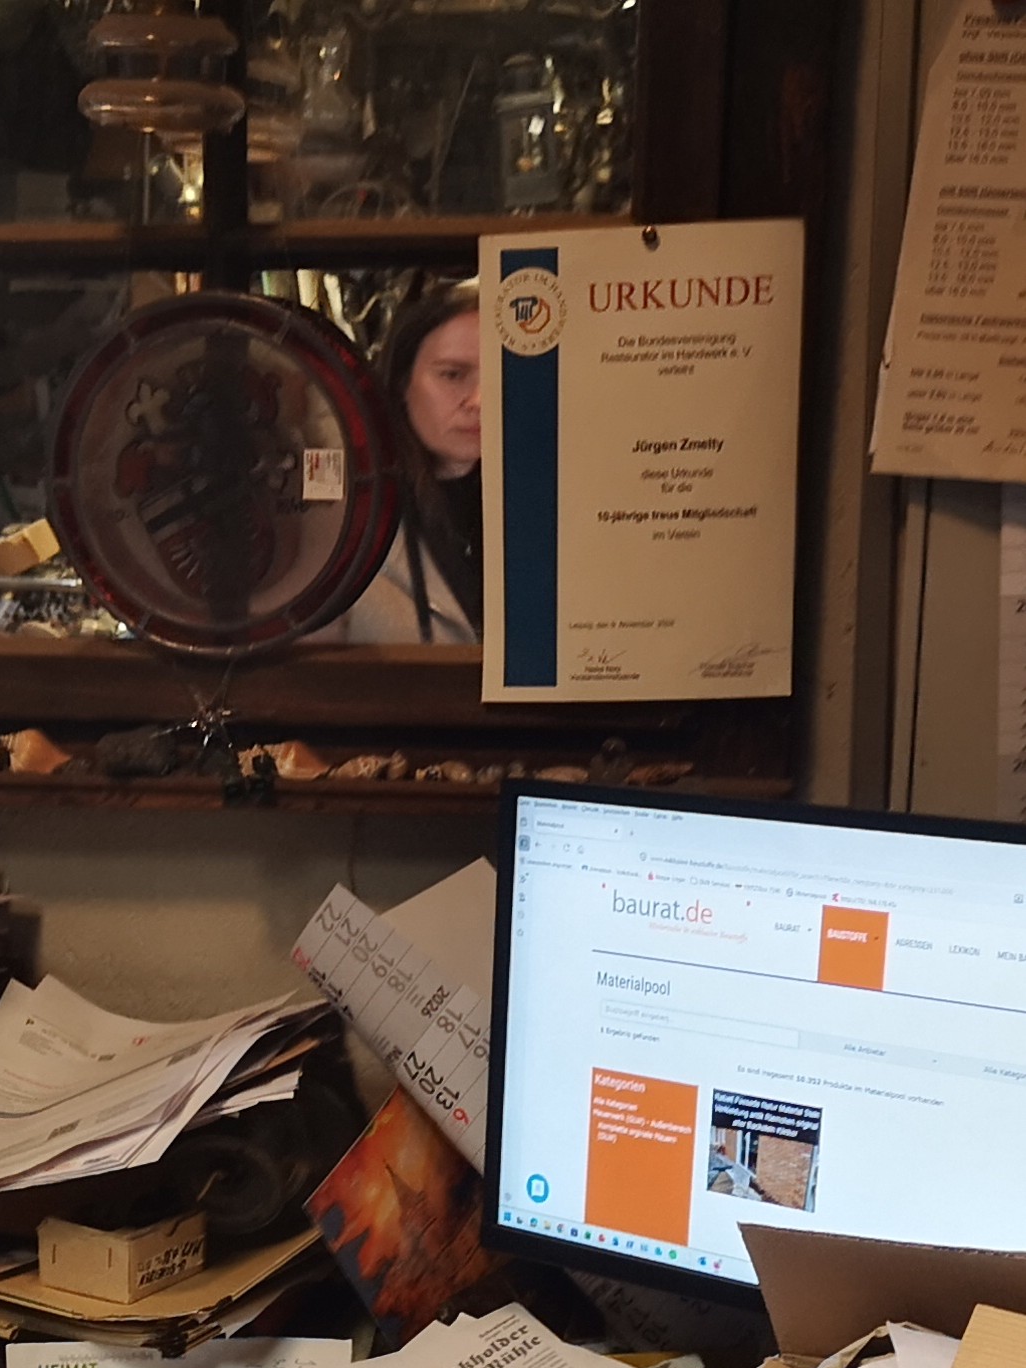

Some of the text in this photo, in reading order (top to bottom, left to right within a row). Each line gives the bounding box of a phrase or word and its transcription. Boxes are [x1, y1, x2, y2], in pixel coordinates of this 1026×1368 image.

[588, 274, 774, 313] URKUNDE
[618, 335, 635, 348] Die
[632, 438, 677, 454] Jürgen
[671, 465, 714, 479] Urkunde
[661, 481, 692, 493] für die
[316, 901, 342, 933] 22
[613, 889, 713, 925] baurat.de
[335, 917, 360, 946] 21
[354, 933, 378, 963] 20
[371, 953, 395, 979] 19
[388, 969, 413, 993] 18
[596, 971, 671, 996] Materialpool
[421, 985, 451, 1018] 2026
[437, 1008, 463, 1033] 18
[458, 1023, 481, 1050] 17
[404, 1051, 425, 1082] 27
[419, 1066, 444, 1094] 20
[594, 1073, 646, 1094] Kategorien
[436, 1086, 459, 1111] 13
